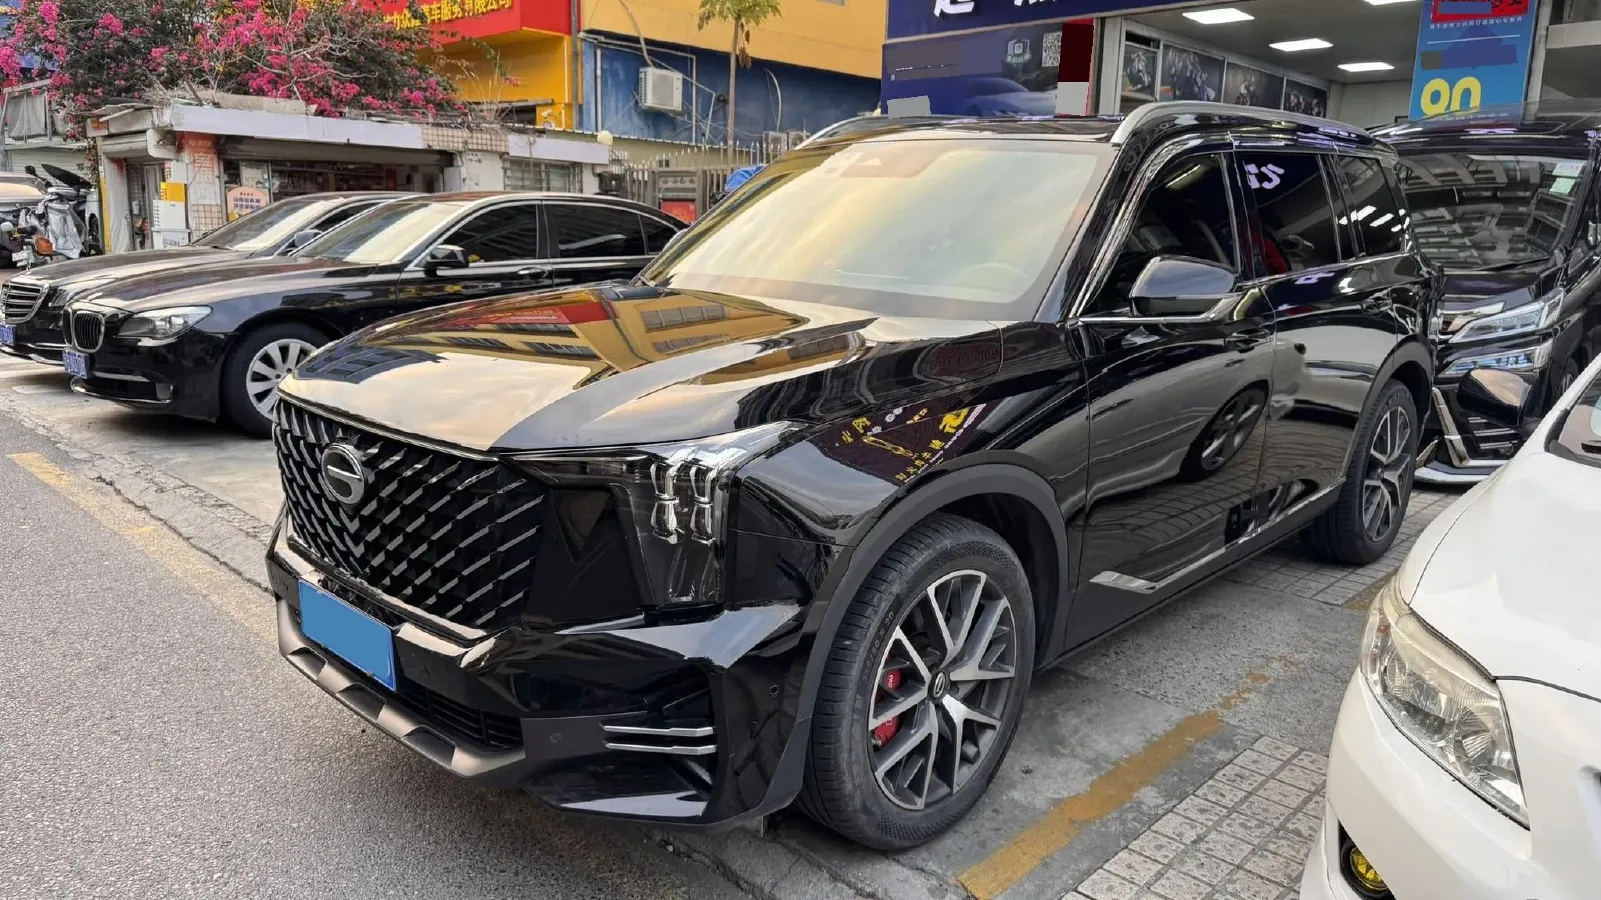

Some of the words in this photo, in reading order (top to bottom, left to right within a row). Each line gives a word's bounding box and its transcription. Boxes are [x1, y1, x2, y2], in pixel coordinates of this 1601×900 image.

[384, 0, 512, 29] 力众汽车服务有限公司
